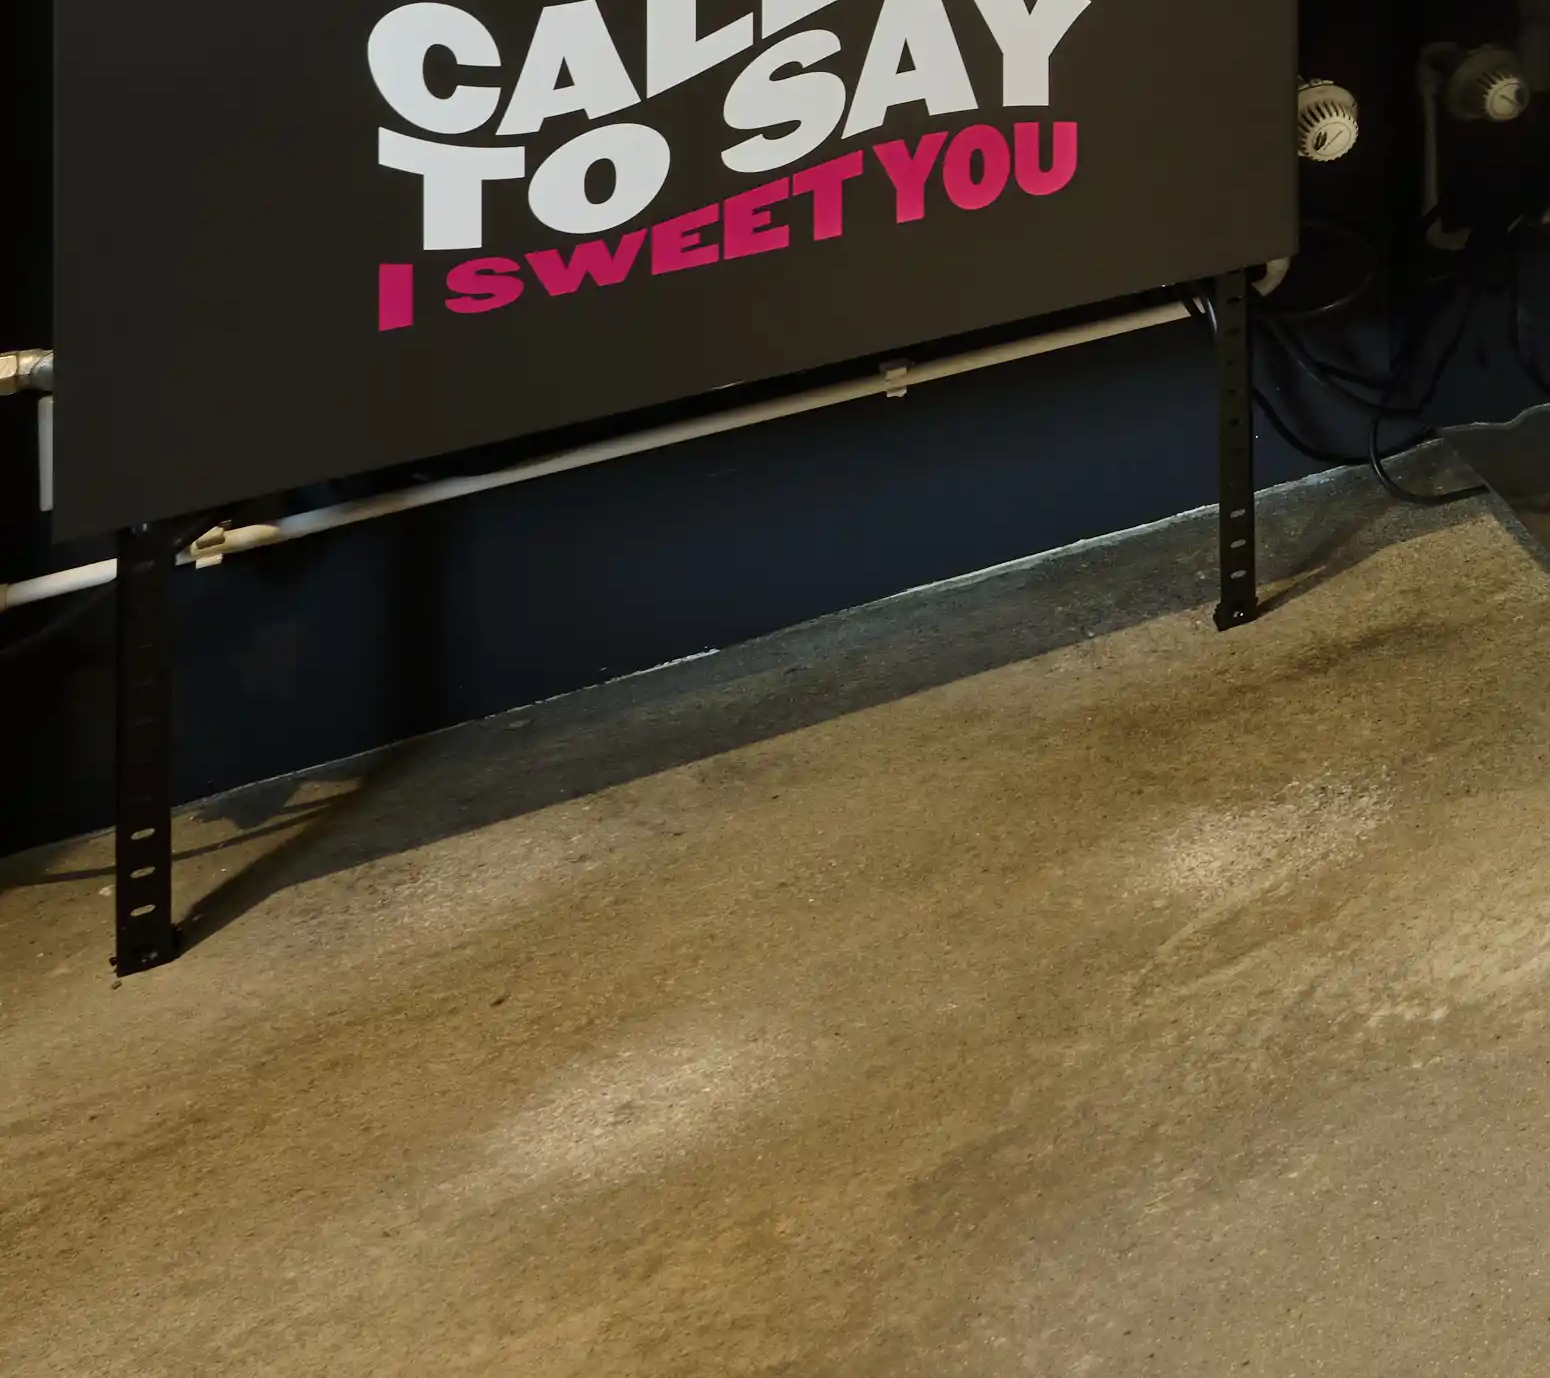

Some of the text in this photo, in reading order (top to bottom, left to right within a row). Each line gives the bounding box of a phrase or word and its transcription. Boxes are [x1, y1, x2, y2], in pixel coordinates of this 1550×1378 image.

[379, 124, 670, 250] TO
[379, 122, 1077, 331] I SWEET YOU
